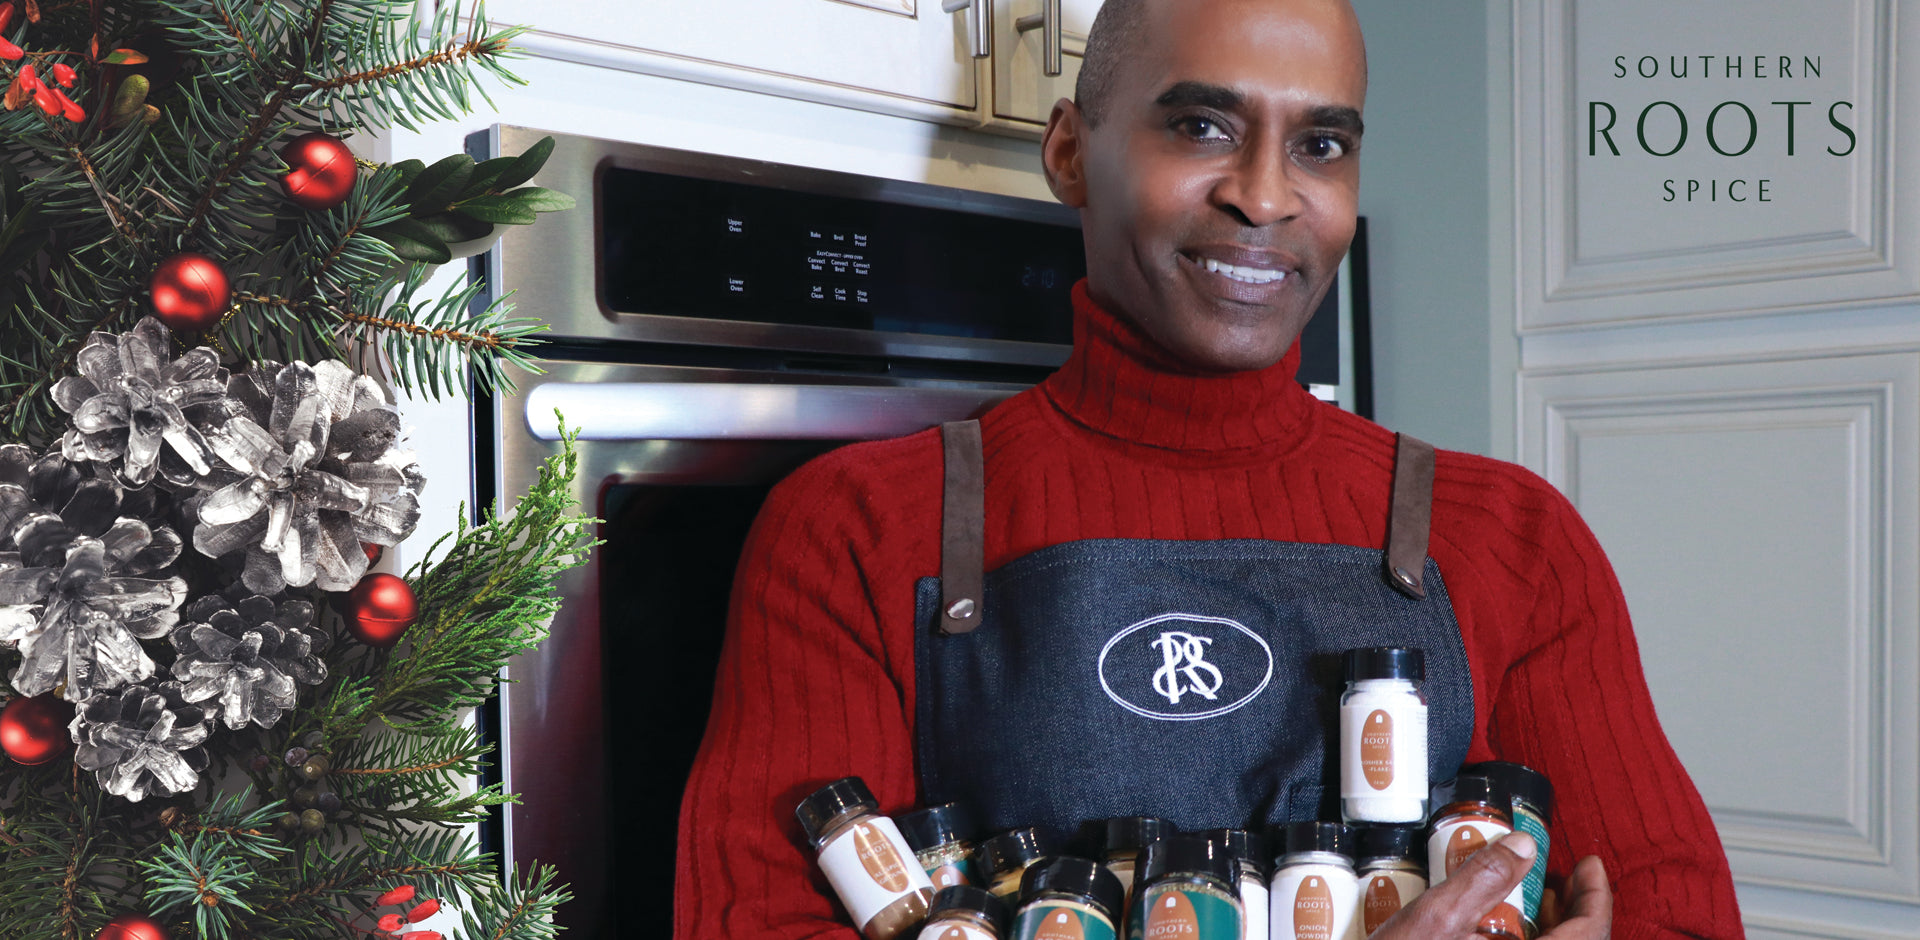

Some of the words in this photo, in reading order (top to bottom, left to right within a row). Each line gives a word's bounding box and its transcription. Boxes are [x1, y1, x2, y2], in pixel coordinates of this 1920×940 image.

[728, 218, 742, 226] Upper
[1297, 901, 1330, 909] ROOTS
[1148, 924, 1193, 936] ROOTS
